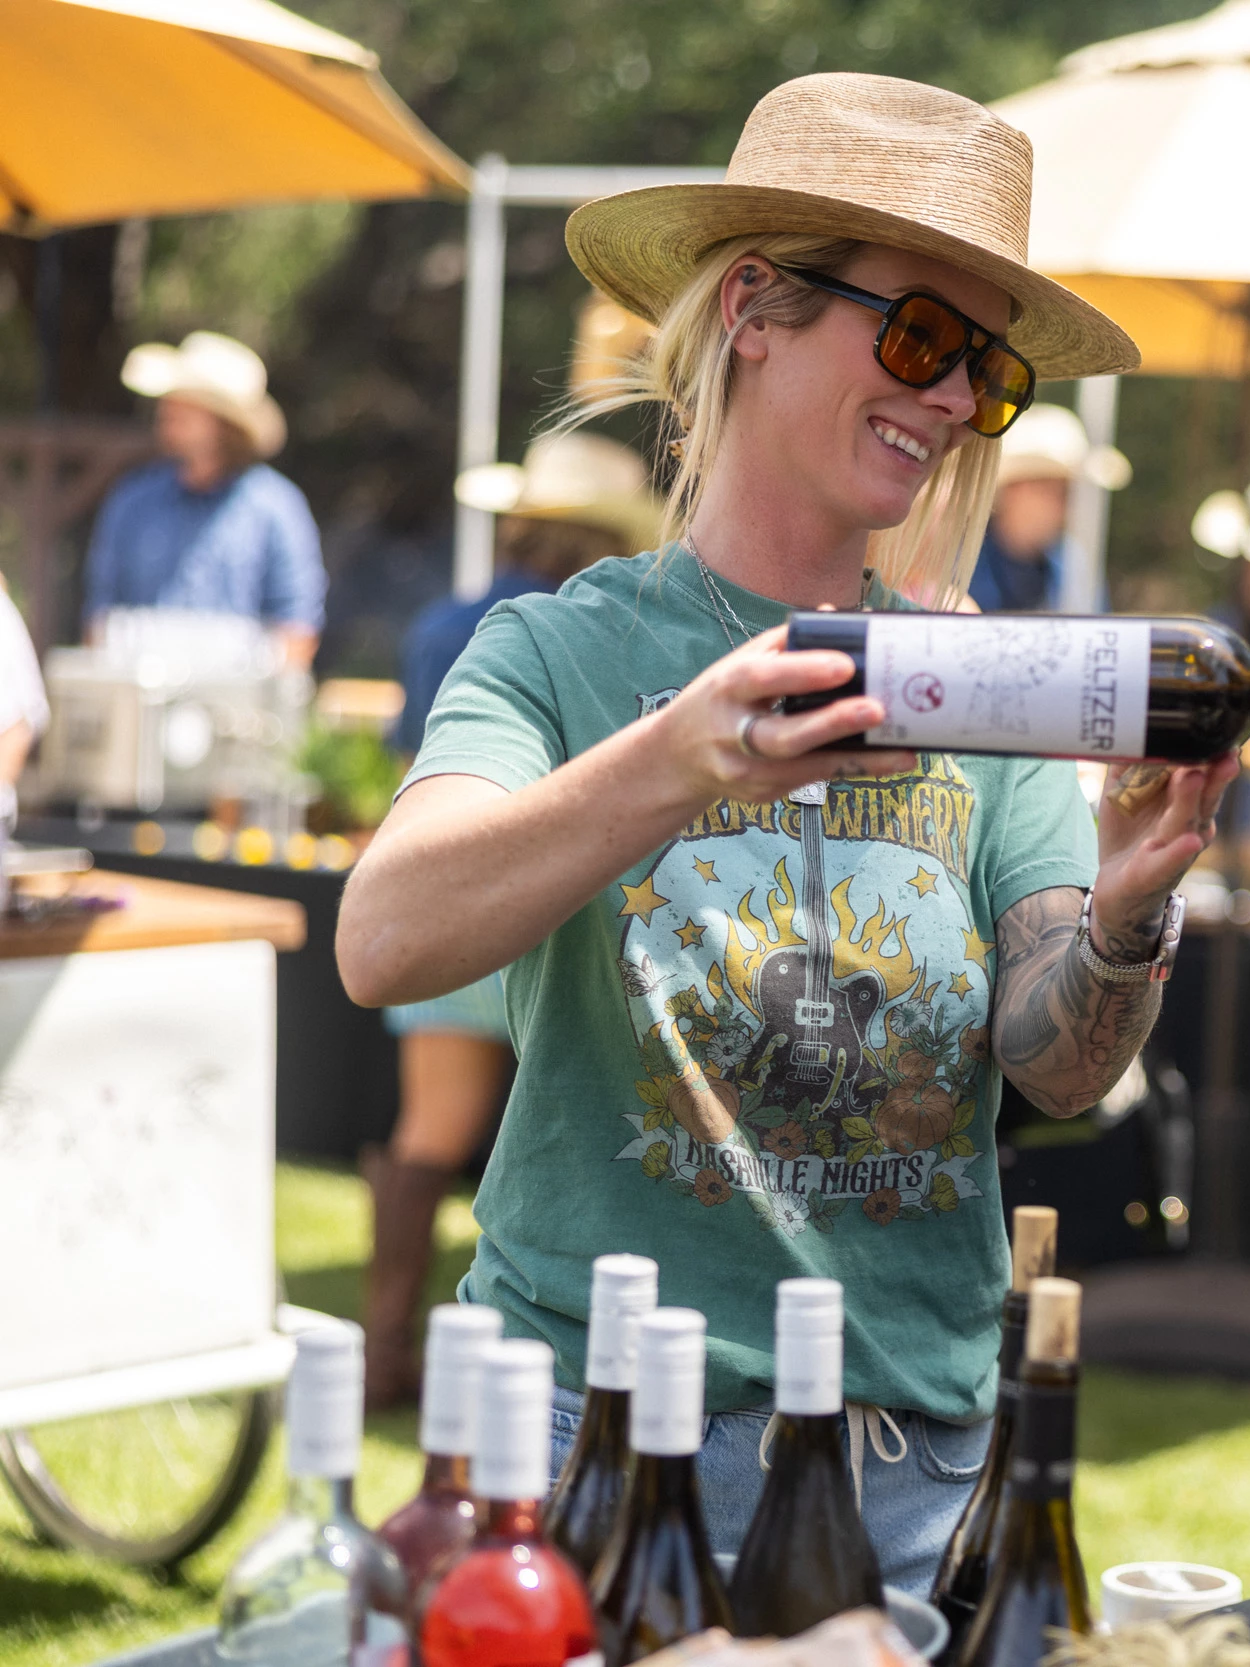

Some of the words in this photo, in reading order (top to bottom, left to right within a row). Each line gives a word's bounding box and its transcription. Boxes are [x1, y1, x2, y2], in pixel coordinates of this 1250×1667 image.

[1091, 630, 1118, 751] PELTZER
[821, 782, 974, 885] WINERY
[820, 1153, 924, 1195] NIGHTS
